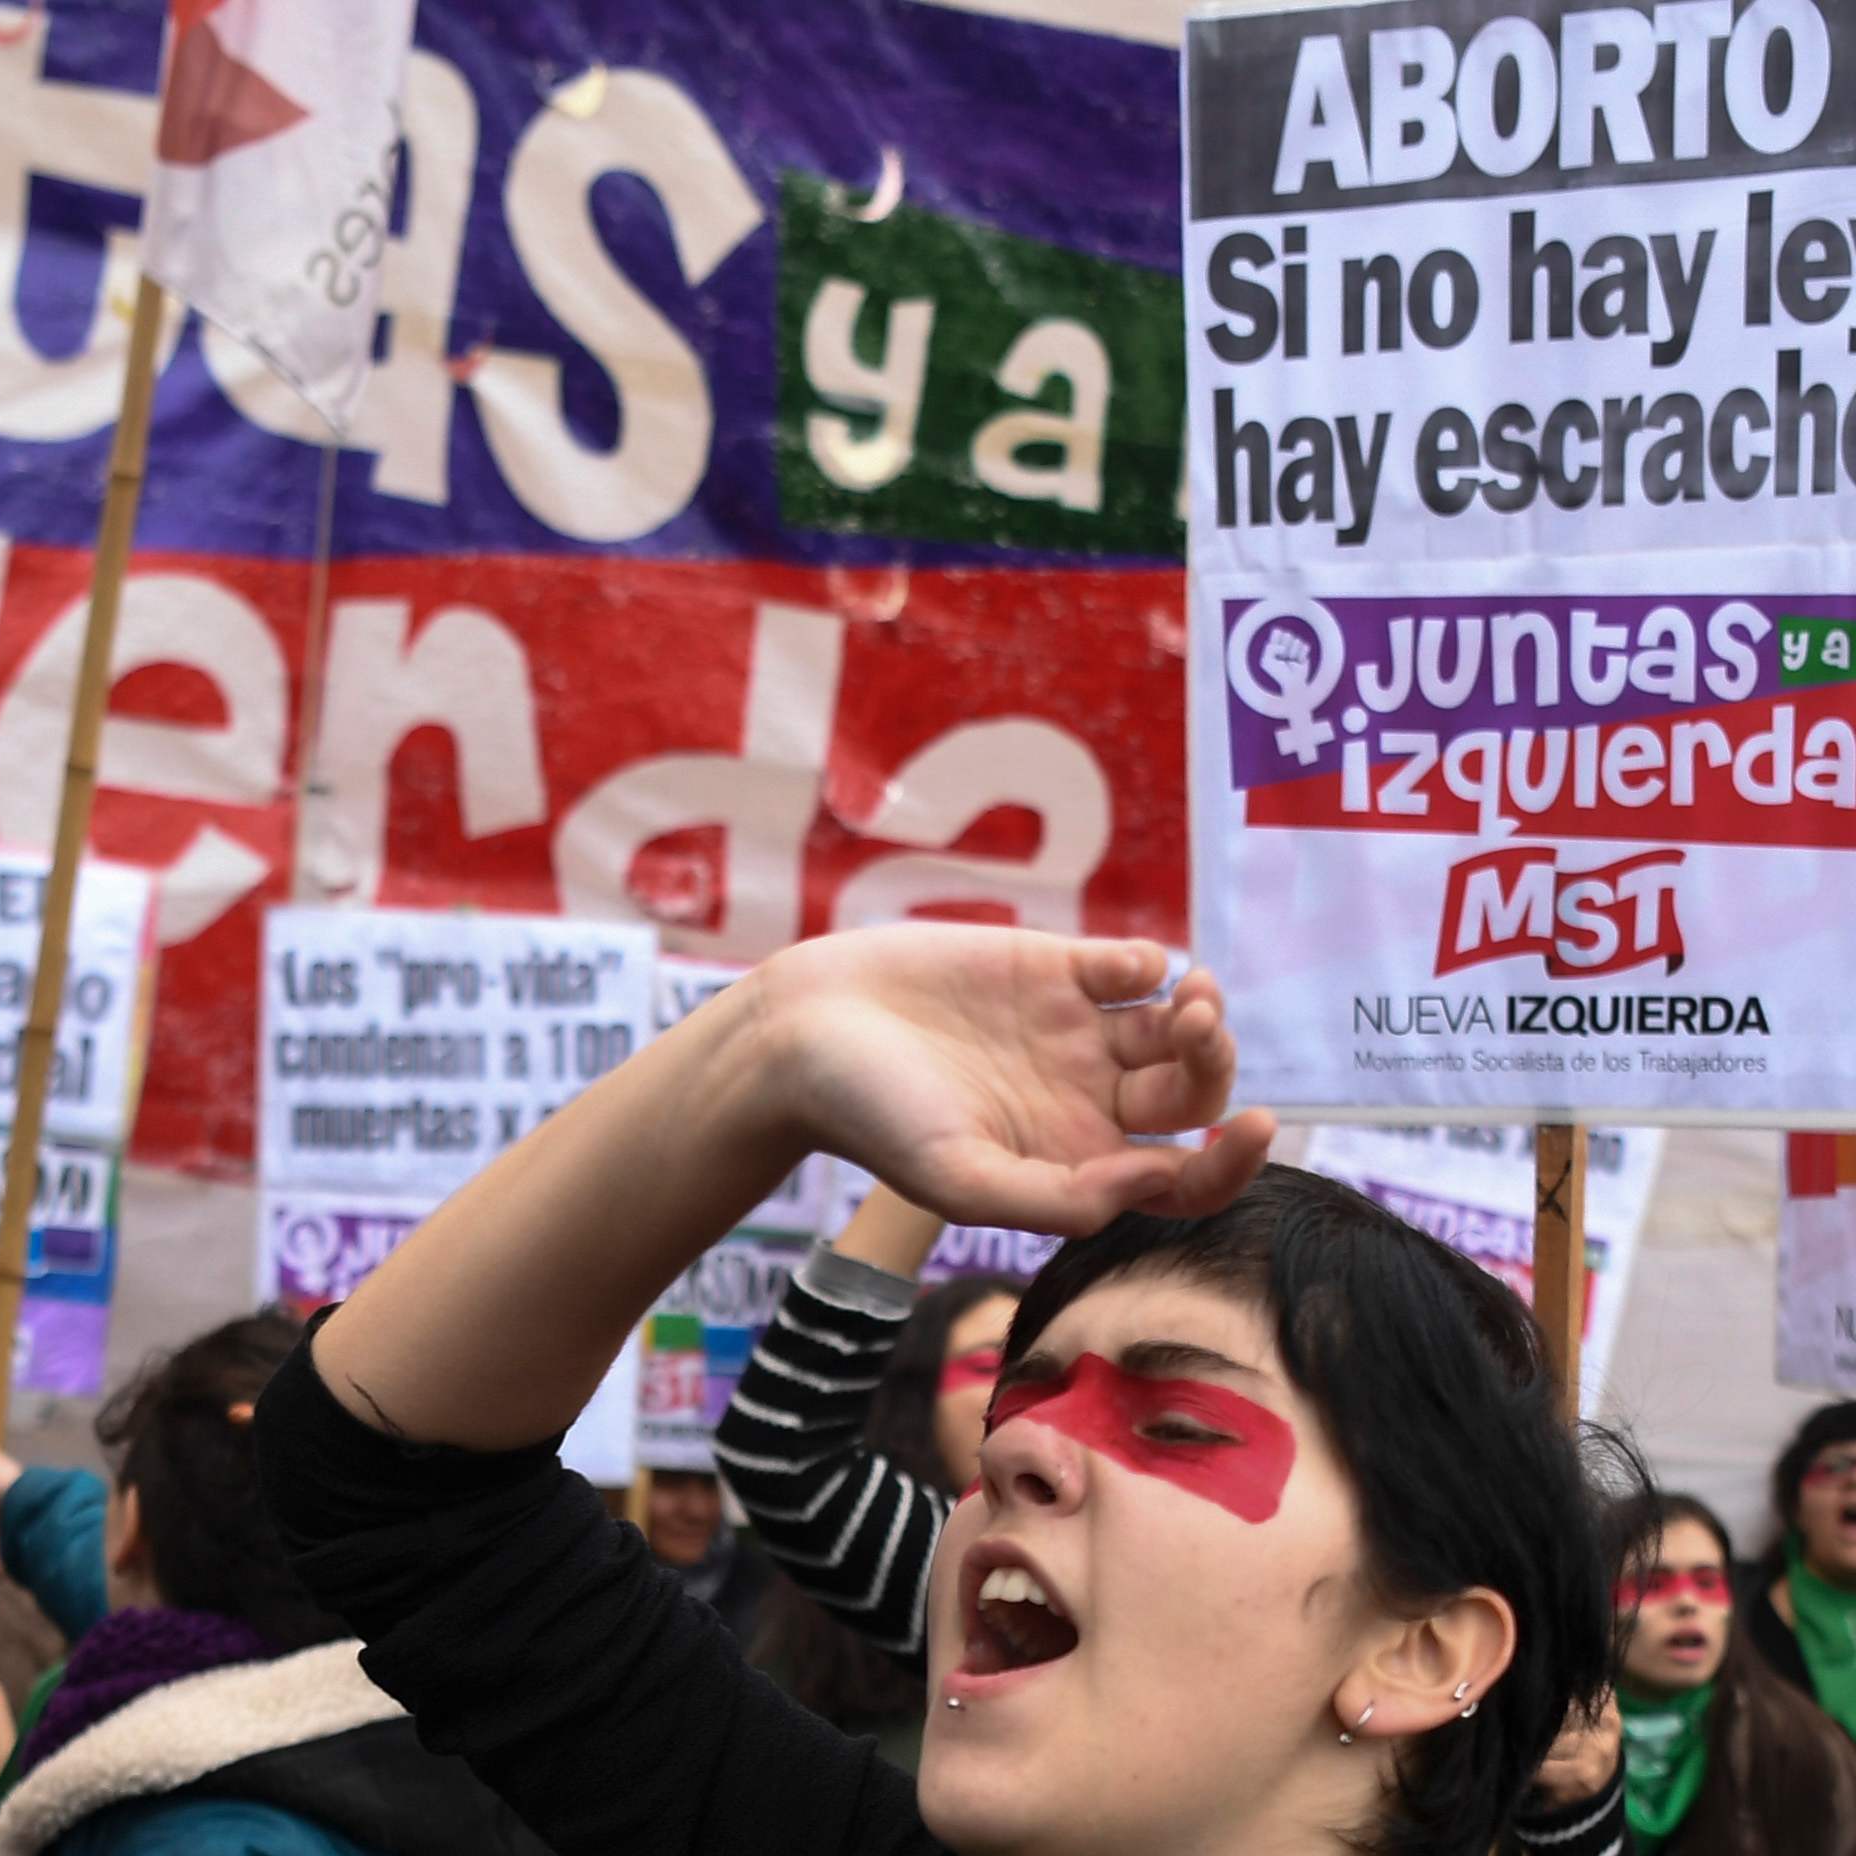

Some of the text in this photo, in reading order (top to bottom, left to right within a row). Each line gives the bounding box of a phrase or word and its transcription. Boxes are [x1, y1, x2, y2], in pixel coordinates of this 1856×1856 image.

[1271, 0, 1832, 196] ABORTO
[1204, 225, 1309, 366] Si
[1343, 247, 1479, 357] no
[1509, 210, 1717, 368] hay
[802, 276, 937, 494] y
[970, 316, 1113, 514] a
[1213, 388, 1392, 547] hay
[1781, 627, 1811, 671] y
[1820, 627, 1850, 671] a
[1452, 848, 1687, 970] MST
[282, 952, 360, 1007] Los
[1352, 994, 1772, 1038] NUEVA IZQUIERDA
[504, 1032, 530, 1081] a
[1638, 1050, 1768, 1080] Trabajadores
